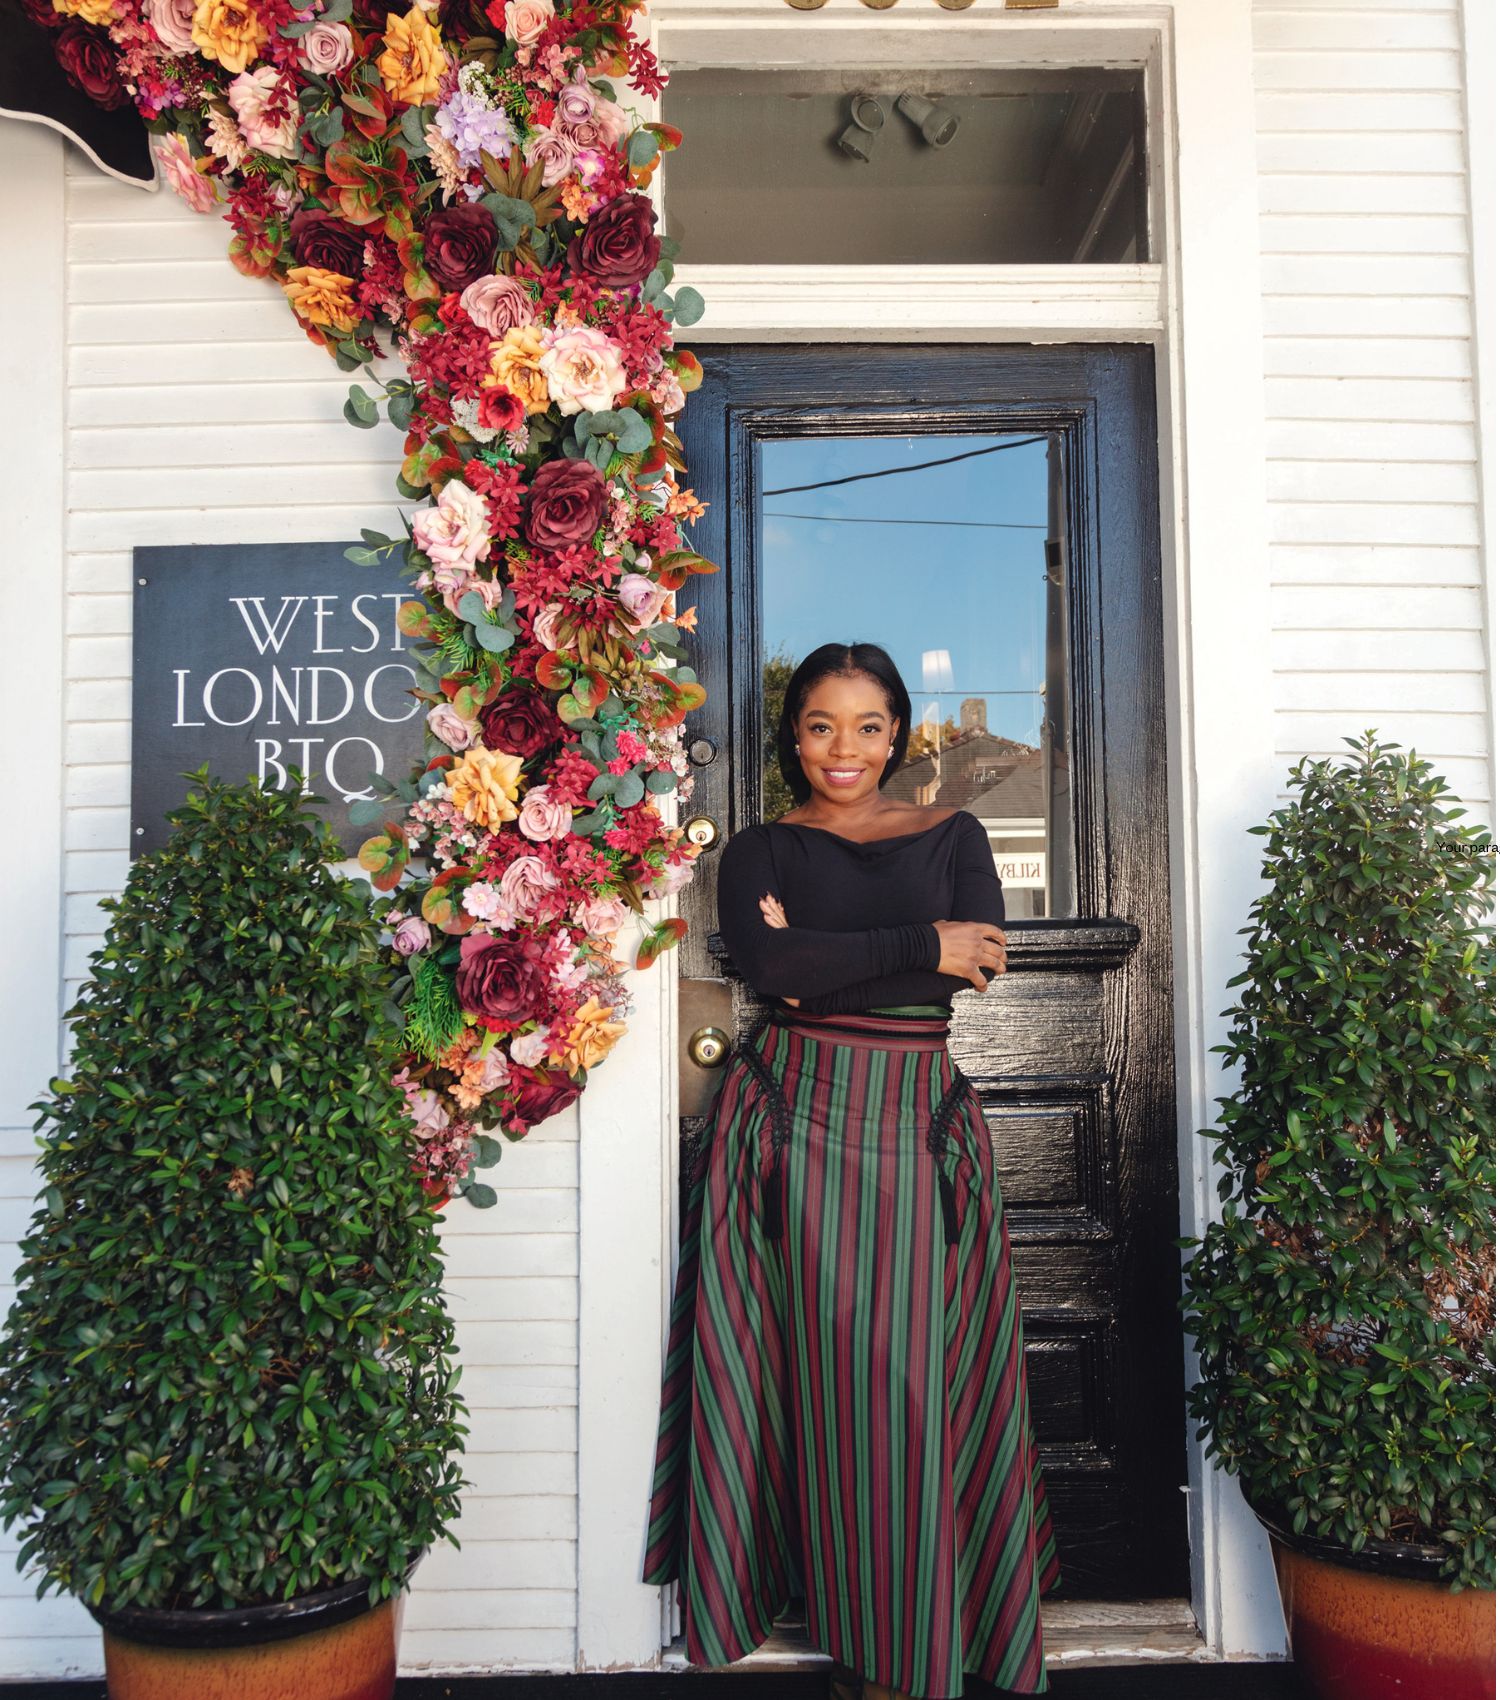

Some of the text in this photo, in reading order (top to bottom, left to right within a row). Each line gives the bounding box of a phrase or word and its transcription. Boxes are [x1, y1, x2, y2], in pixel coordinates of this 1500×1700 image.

[229, 593, 415, 655] WEST
[172, 664, 422, 726] LONDO
[255, 736, 384, 803] BTQ
